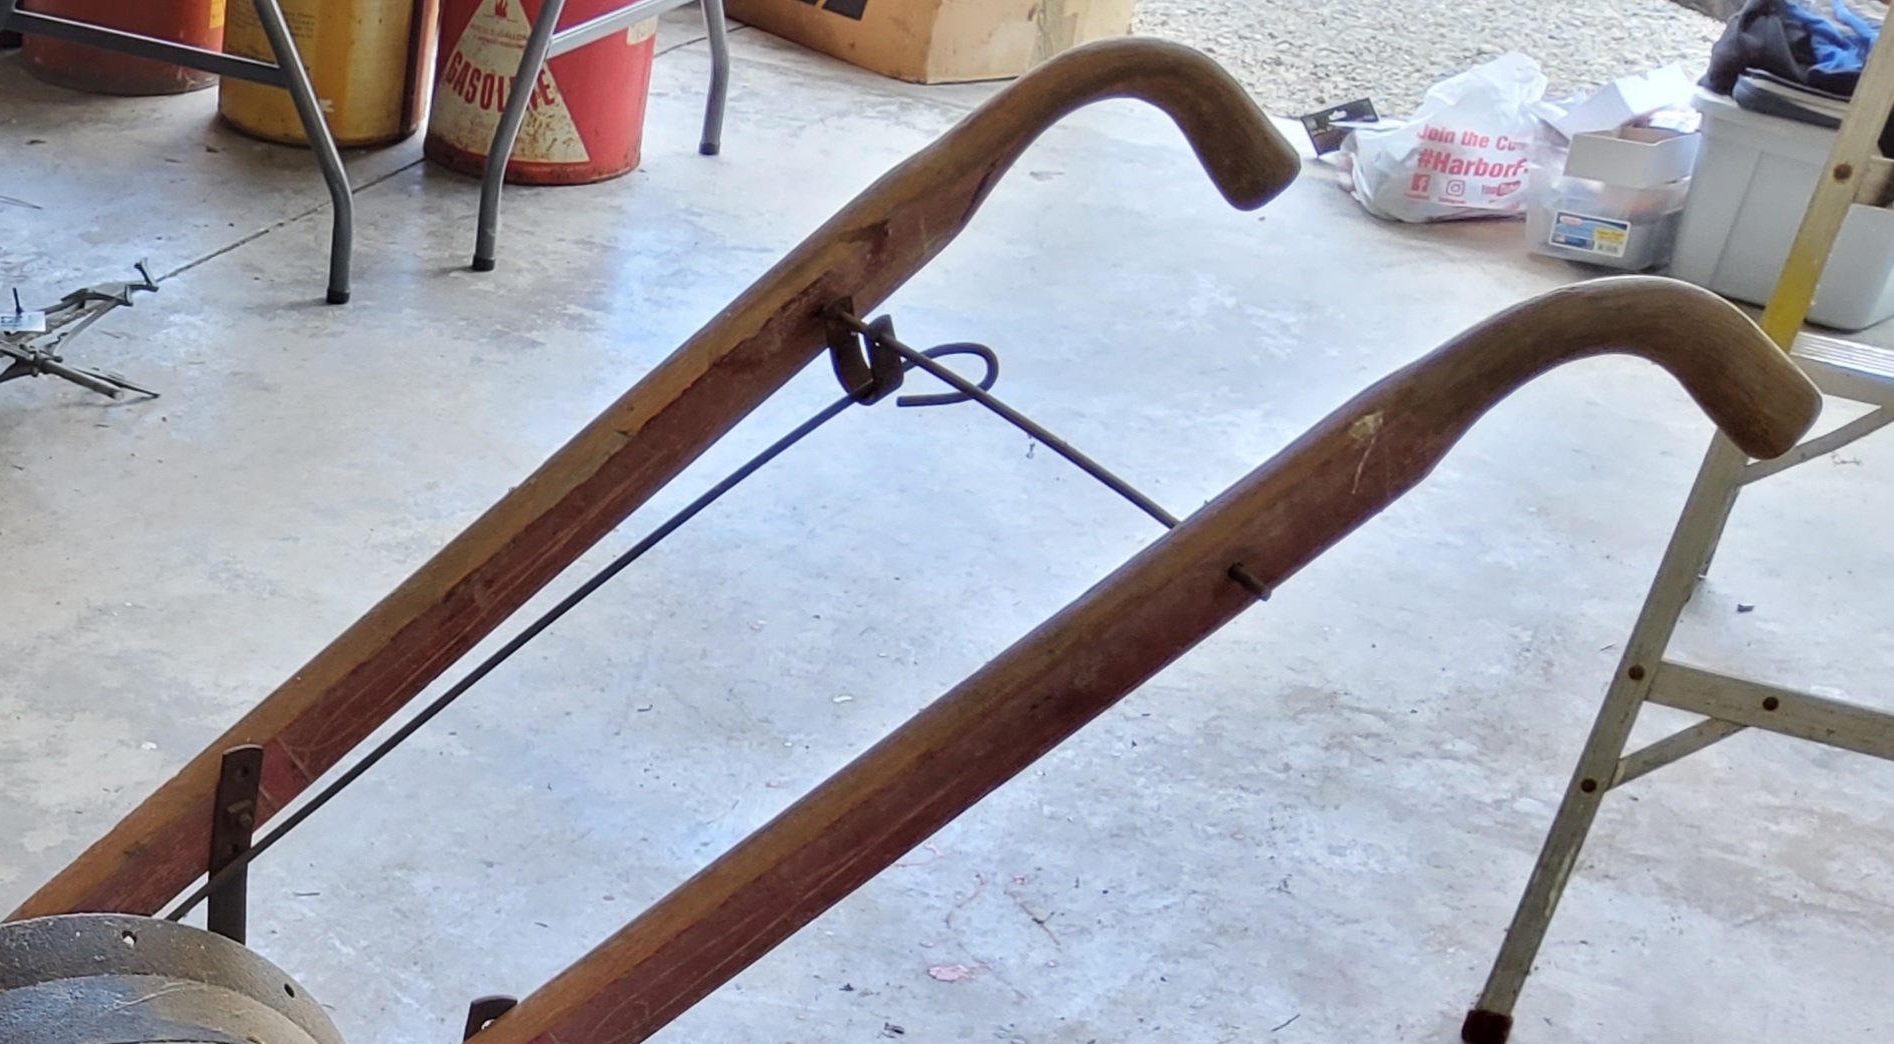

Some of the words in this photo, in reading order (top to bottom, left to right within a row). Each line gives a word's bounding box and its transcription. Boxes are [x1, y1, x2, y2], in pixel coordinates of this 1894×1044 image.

[445, 50, 555, 112] GASOLE
[1418, 124, 1456, 144] Join
[1461, 130, 1490, 148] the
